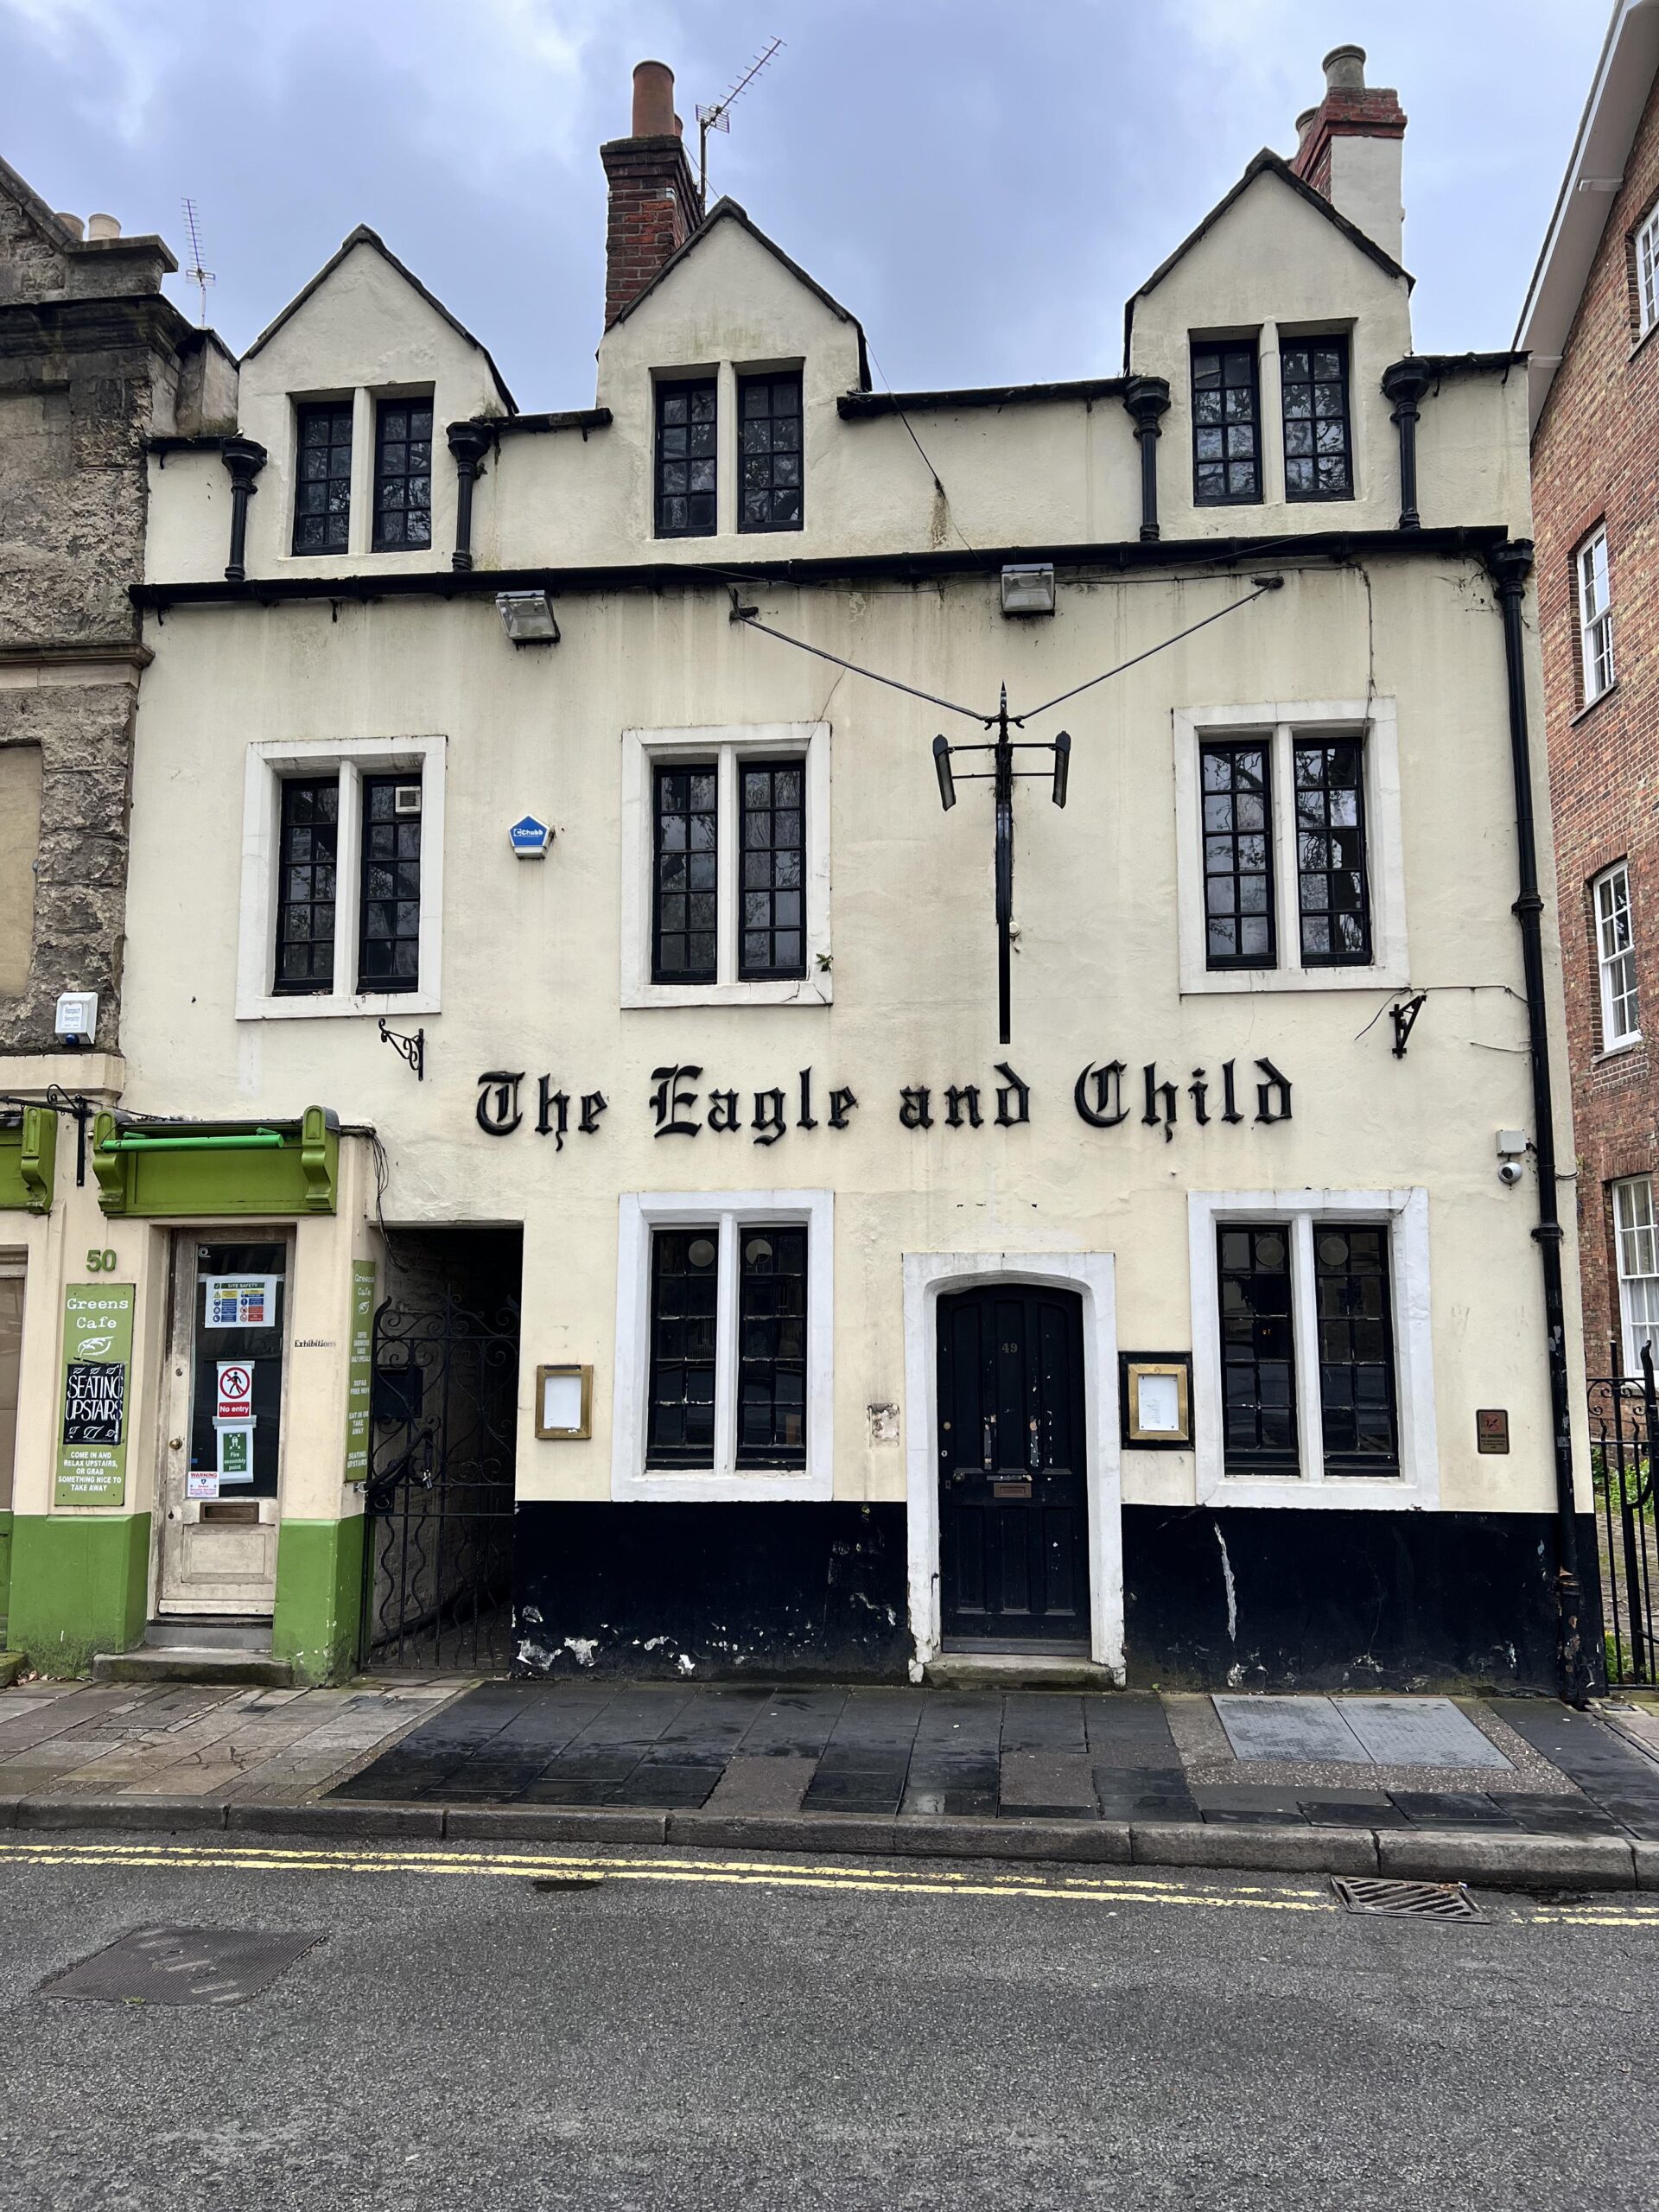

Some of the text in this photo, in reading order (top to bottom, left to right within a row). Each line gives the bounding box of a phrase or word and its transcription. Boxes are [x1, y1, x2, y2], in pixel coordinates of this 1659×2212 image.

[476, 1057, 1294, 1152] The Eagle and Child
[86, 1249, 117, 1272] 50
[354, 1274, 375, 1283] Greens
[358, 1287, 372, 1296] Cafe
[67, 1298, 129, 1310] Greens
[76, 1316, 118, 1329] Cafe
[294, 1339, 337, 1348] Exhibitions
[1002, 1343, 1018, 1353] 49
[67, 1375, 124, 1399] SEATING
[65, 1399, 124, 1421] UPSTAIRS
[348, 1451, 367, 1460] SEATING
[86, 1459, 118, 1468] UPSTAIRS,
